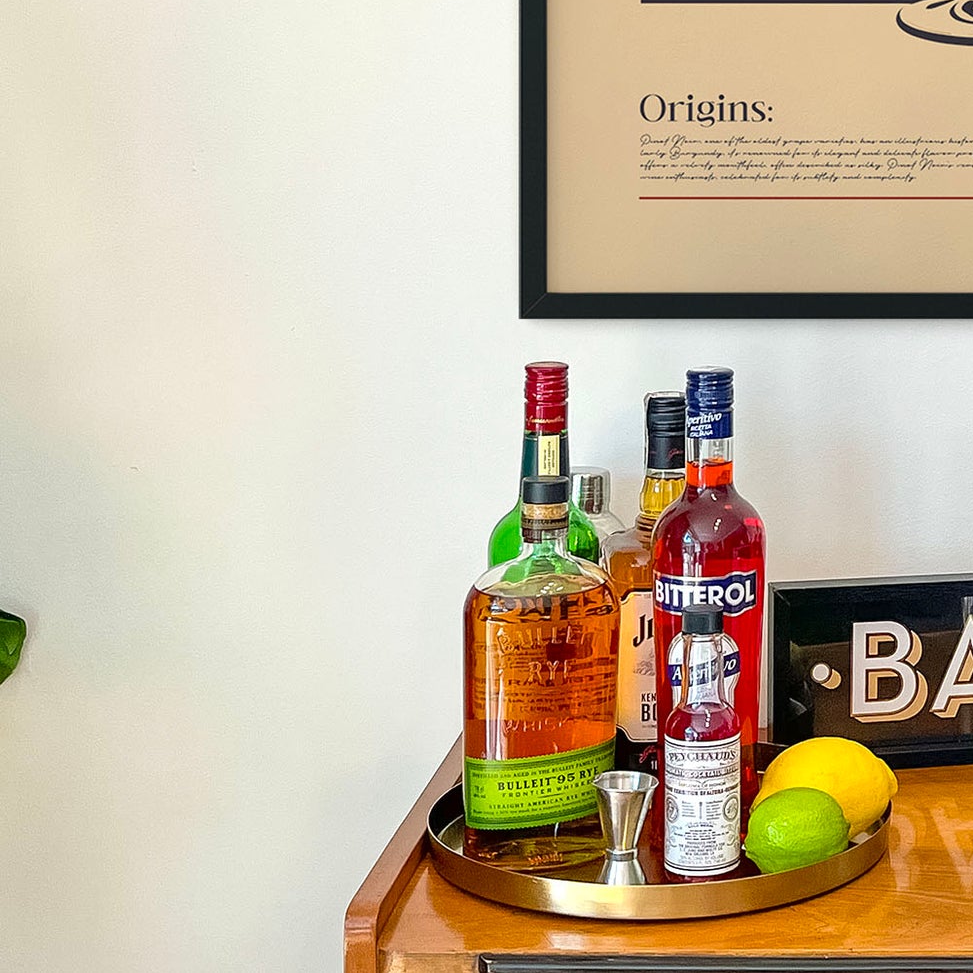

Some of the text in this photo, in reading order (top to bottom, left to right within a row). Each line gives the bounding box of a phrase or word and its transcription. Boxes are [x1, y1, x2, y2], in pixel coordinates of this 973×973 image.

[639, 93, 774, 128] Origins:
[639, 133, 671, 148] Pinot
[752, 135, 782, 147] oldest
[823, 147, 862, 159] elegant
[686, 412, 722, 427] peritivo
[655, 579, 755, 609] BITTEROL
[497, 776, 556, 791] BULLEIT
[557, 772, 576, 785] 95
[579, 765, 599, 779] RYE
[502, 779, 594, 798] FRONTIER WHISKE
